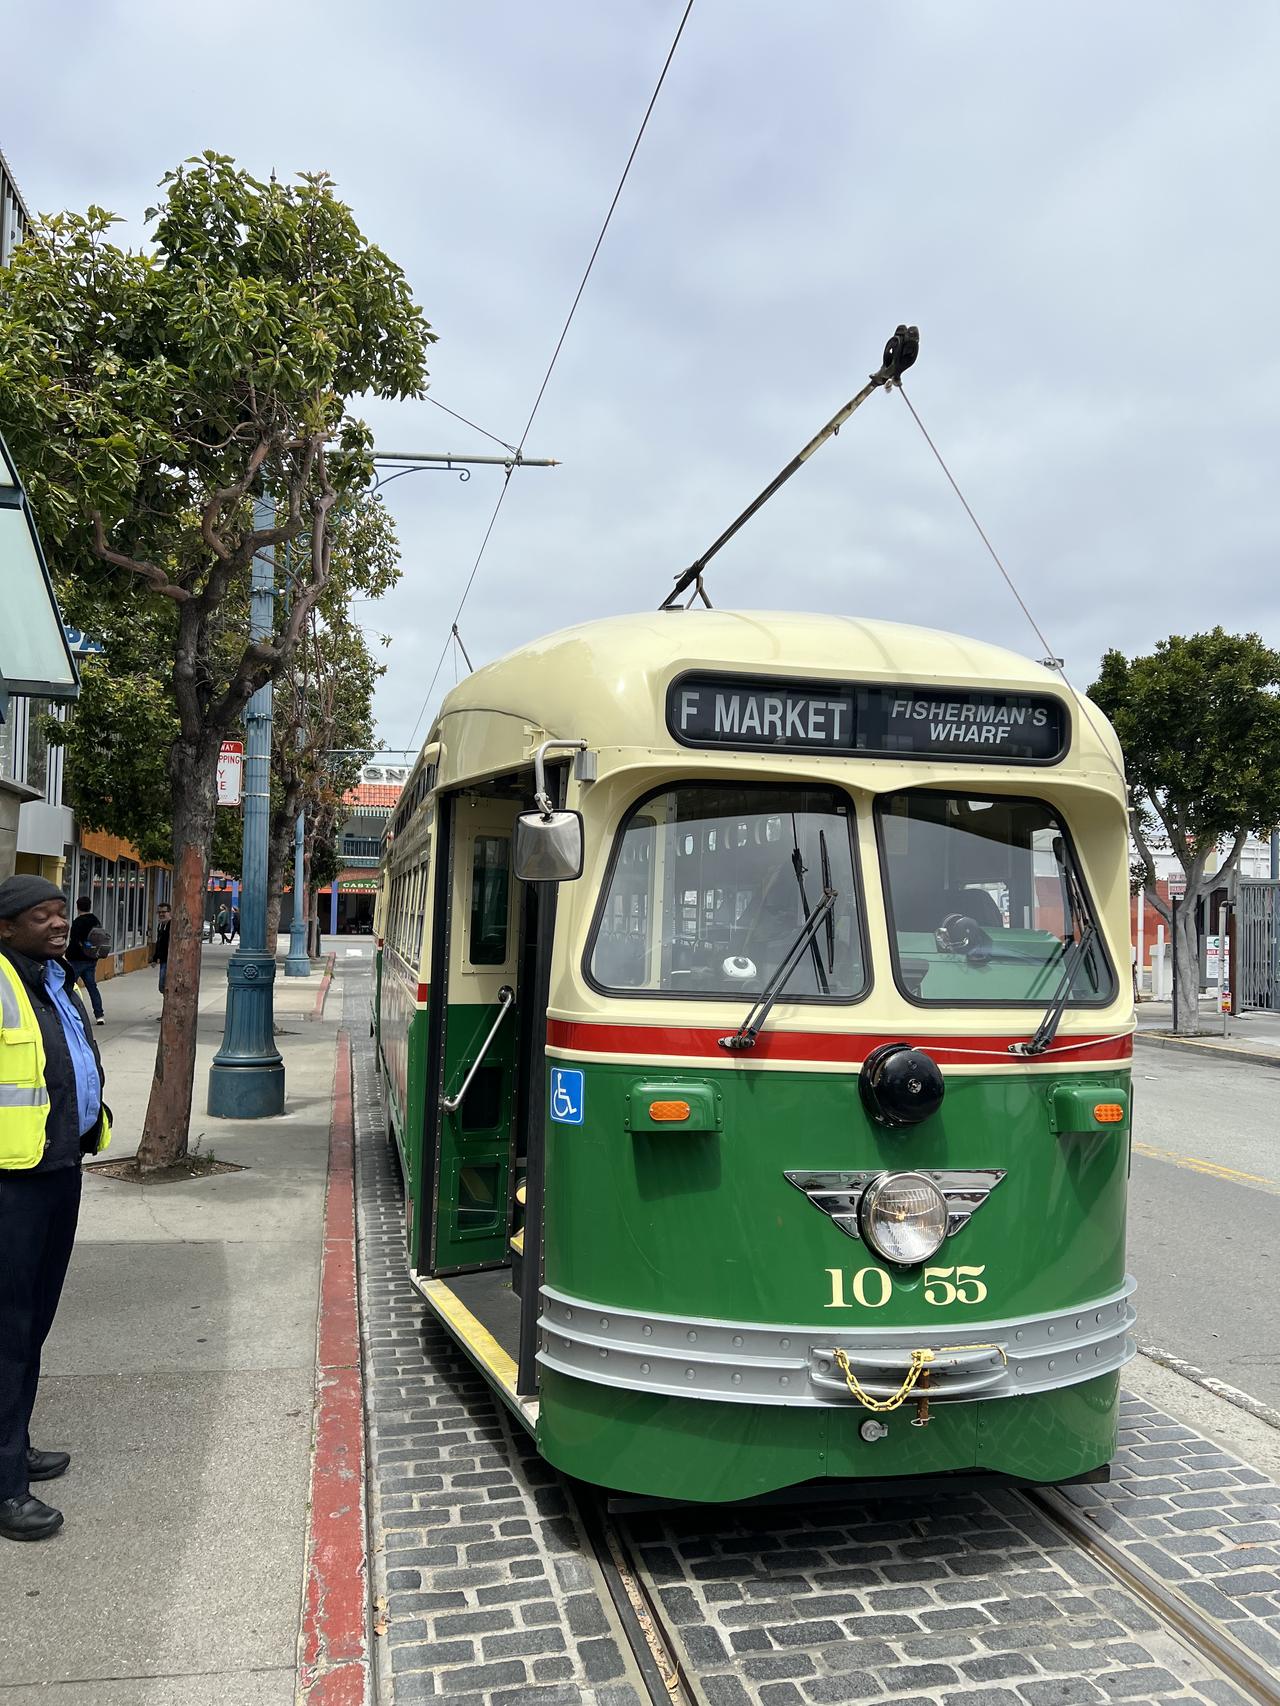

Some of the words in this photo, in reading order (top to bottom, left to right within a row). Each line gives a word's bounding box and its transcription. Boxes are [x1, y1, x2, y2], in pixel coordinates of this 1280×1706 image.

[680, 691, 700, 730] F
[714, 693, 848, 741] MARKET
[891, 700, 1048, 727] FISHERMAN'S
[929, 722, 1011, 745] WHARF
